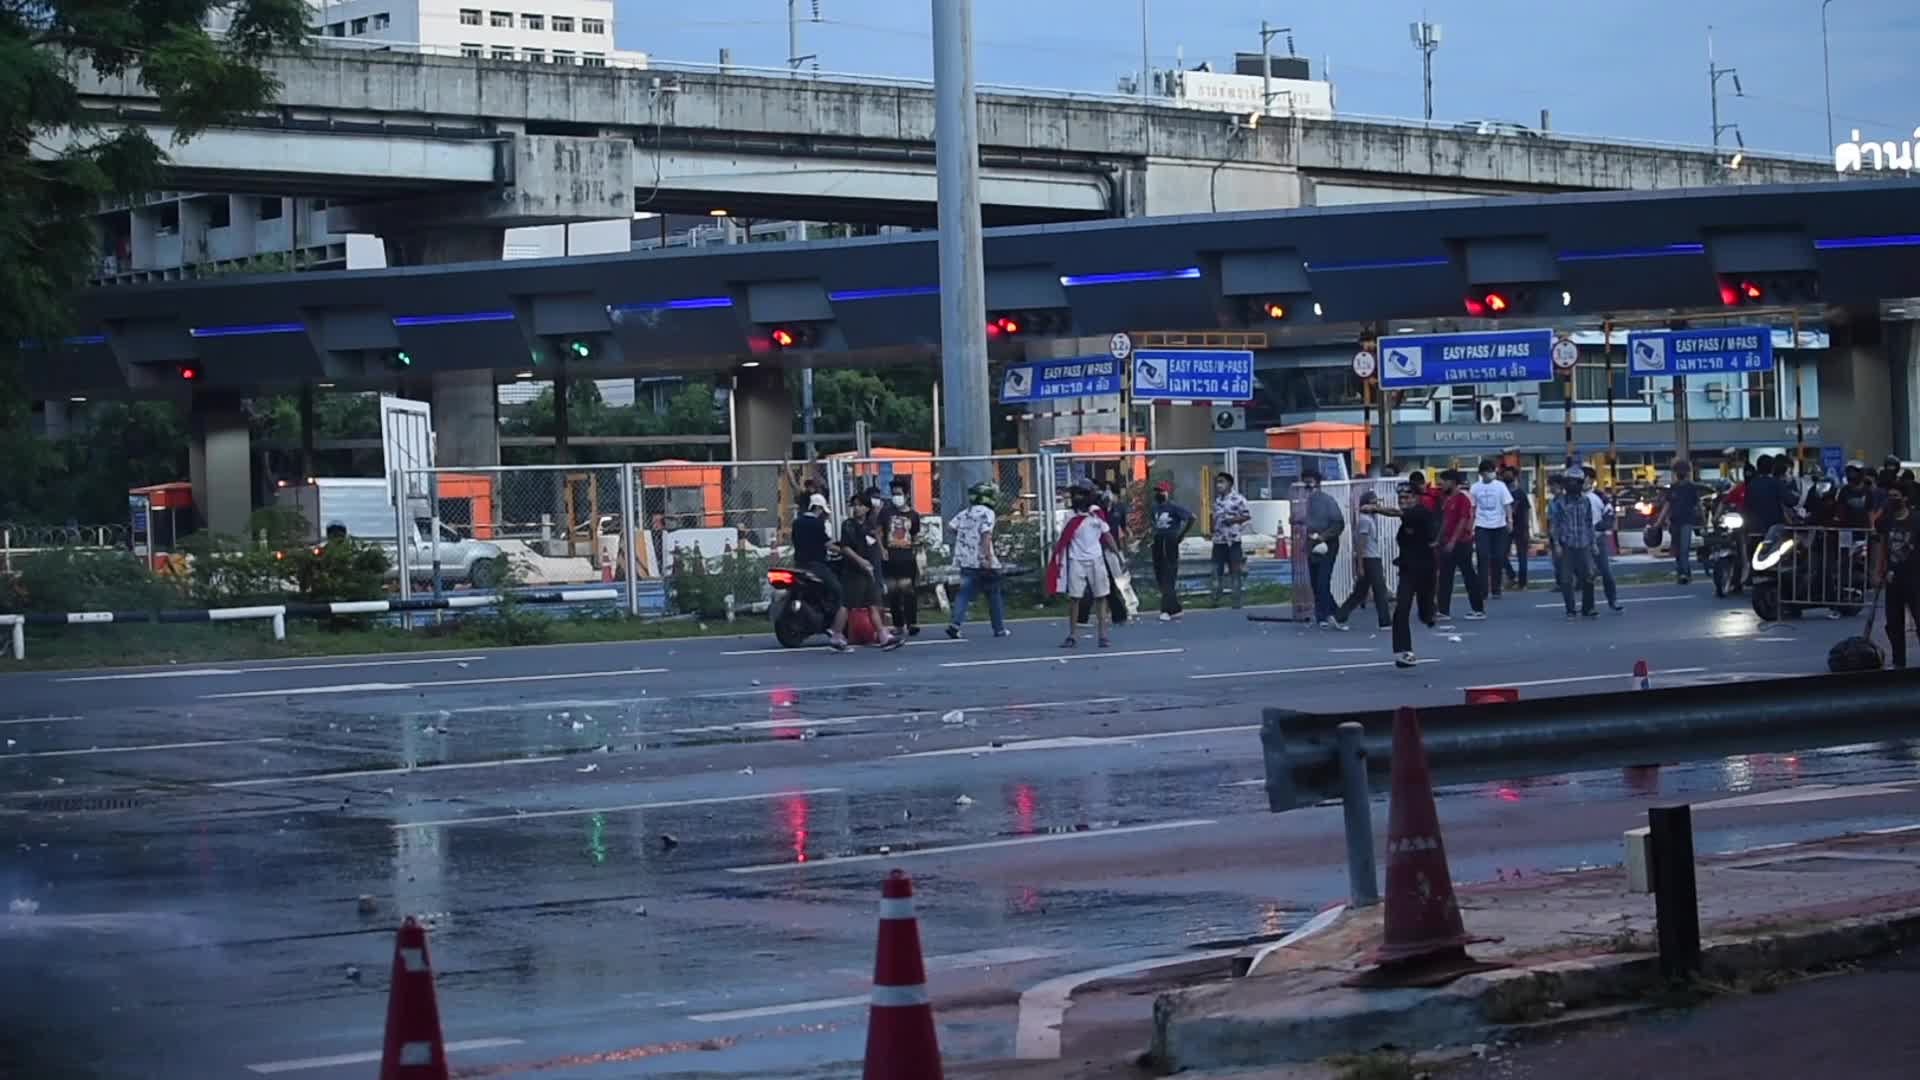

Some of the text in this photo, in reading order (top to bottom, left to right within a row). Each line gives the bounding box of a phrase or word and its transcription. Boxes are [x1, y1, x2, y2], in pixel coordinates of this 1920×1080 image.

[1835, 125, 1920, 172] ด่าน
[1443, 346, 1465, 360] EASY
[1467, 345, 1488, 359] PASS
[1676, 338, 1697, 353] EASY
[1698, 337, 1719, 351] PASS
[1169, 359, 1191, 373] EASY
[1730, 356, 1738, 368] 4
[1043, 367, 1061, 380] EASY
[1062, 365, 1081, 378] PASS
[1500, 366, 1508, 377] 4
[1086, 381, 1093, 392] 4
[1169, 375, 1249, 394] เฉพาะรถ 4 ล้อ
